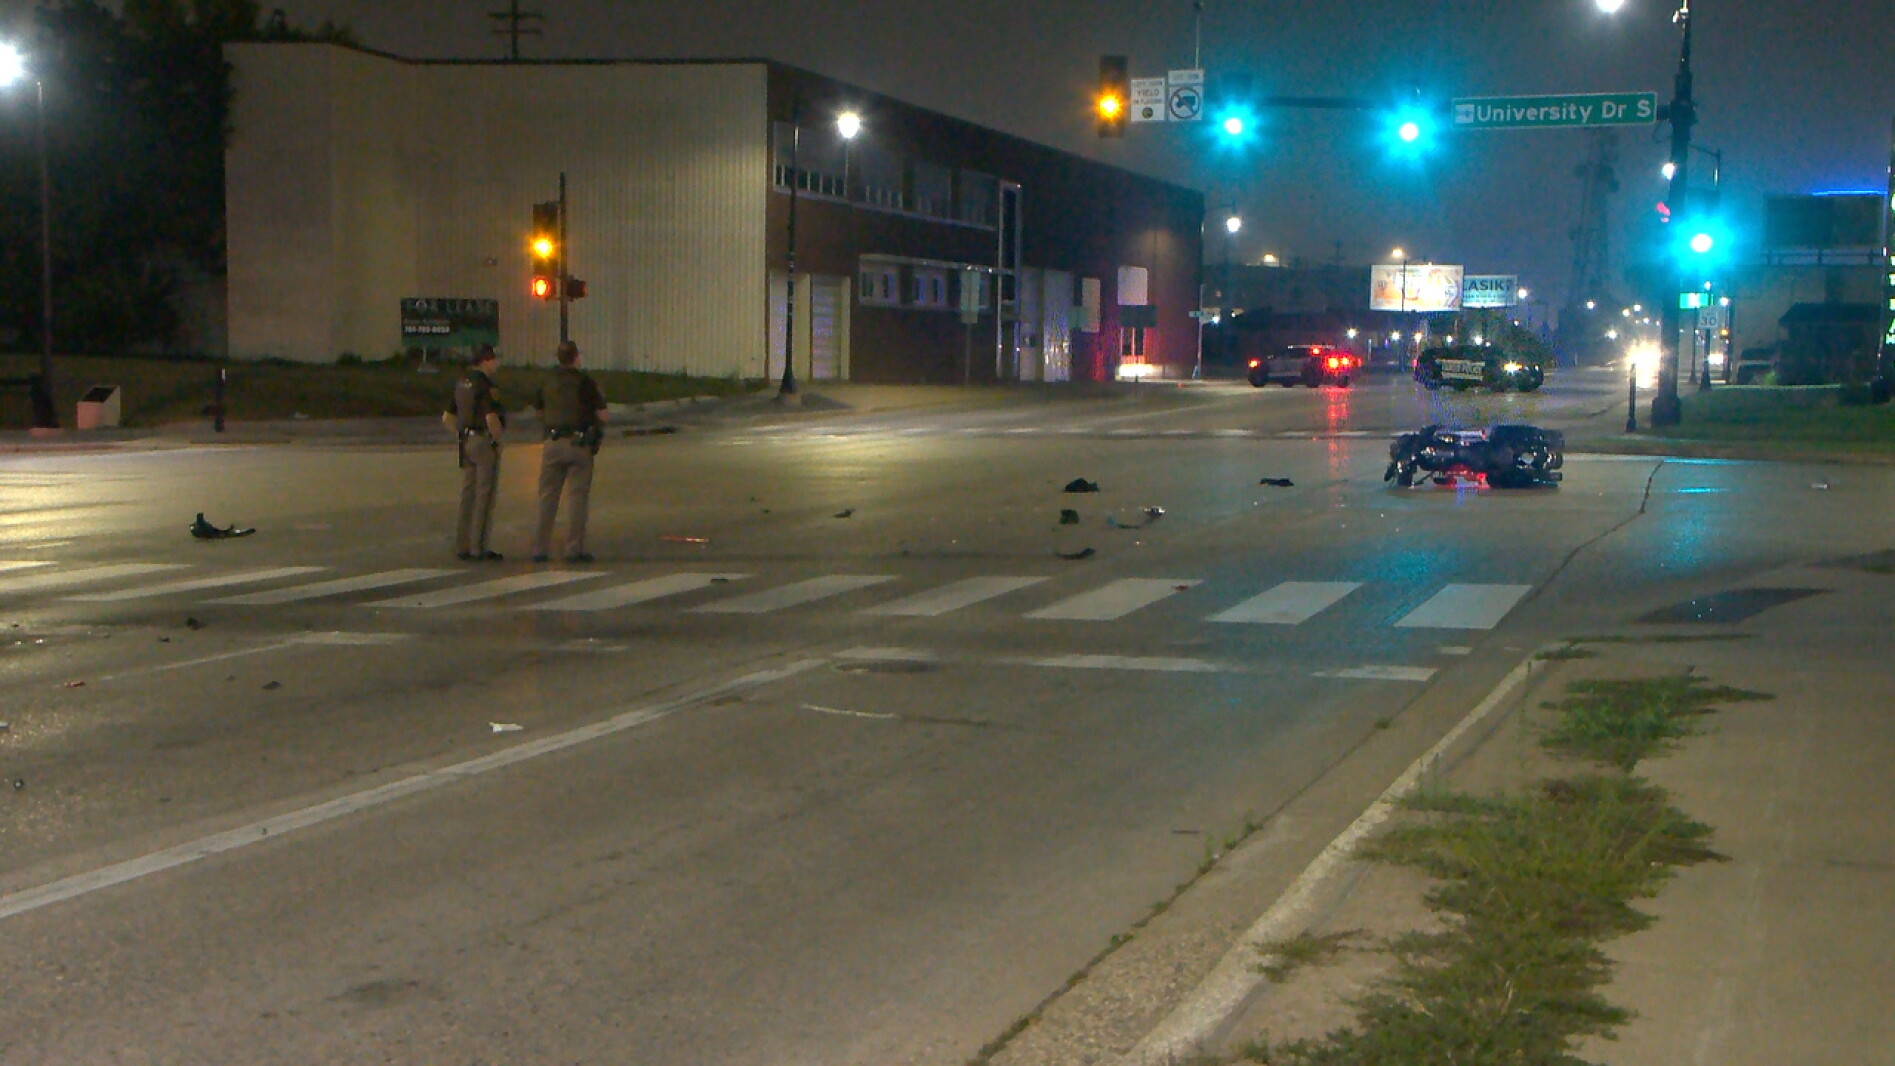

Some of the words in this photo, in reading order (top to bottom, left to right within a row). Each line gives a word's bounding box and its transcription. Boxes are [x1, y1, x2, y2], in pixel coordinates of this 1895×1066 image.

[1137, 88, 1160, 96] YIELD
[1477, 103, 1593, 123] University
[1602, 100, 1628, 119] Dr
[1637, 99, 1652, 118] S
